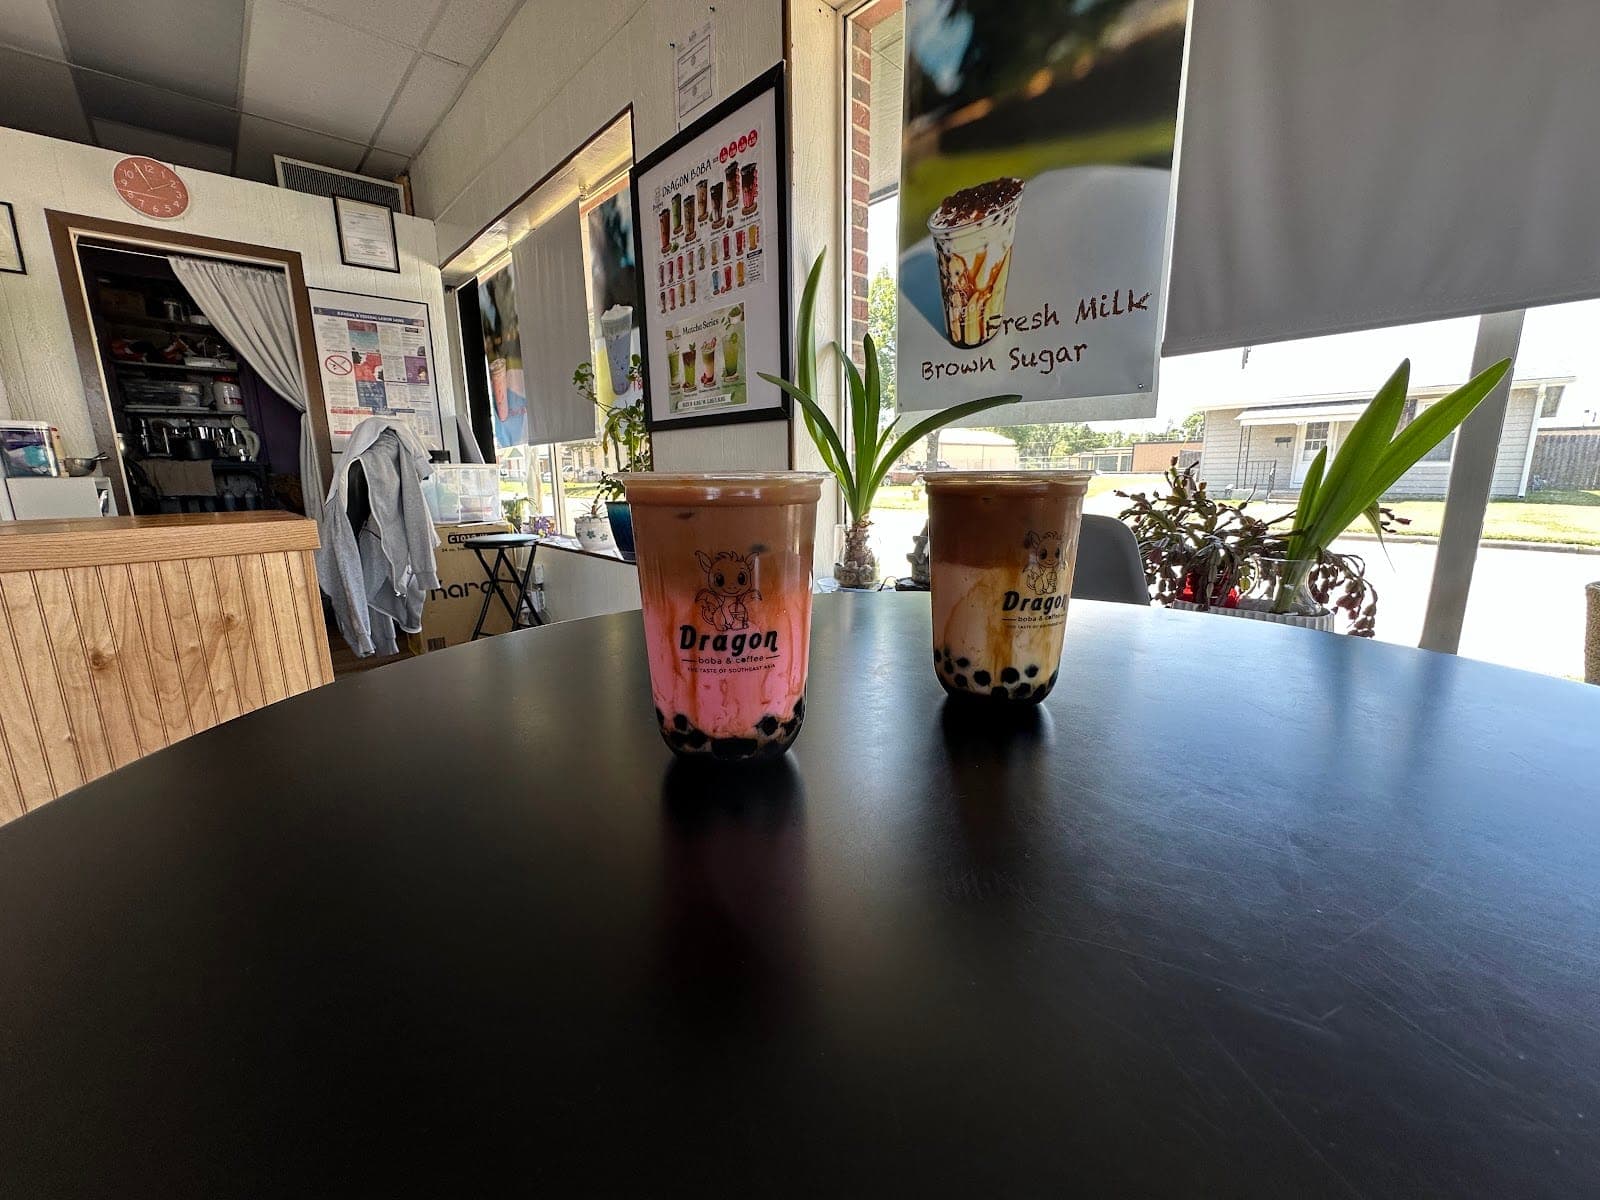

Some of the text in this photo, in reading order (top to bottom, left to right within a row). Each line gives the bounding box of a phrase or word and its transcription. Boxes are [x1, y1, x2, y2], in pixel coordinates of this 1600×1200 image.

[144, 164, 154, 174] 12
[123, 169, 134, 179] 10
[662, 159, 712, 198] DRAGON BOBA
[120, 178, 128, 187] 9
[170, 180, 176, 189] 2
[176, 191, 182, 199] 3
[139, 199, 145, 208] 7
[164, 204, 172, 212] 5
[173, 200, 180, 208] 4
[153, 205, 159, 213] 6
[985, 303, 1060, 337] Fresh
[682, 318, 719, 335] Matcha Series
[921, 342, 1088, 382] Brown Sugar
[680, 624, 778, 657] Dragon
[698, 656, 722, 665] boba
[735, 655, 764, 664] coffee
[728, 665, 762, 673] SOUTHEAST
